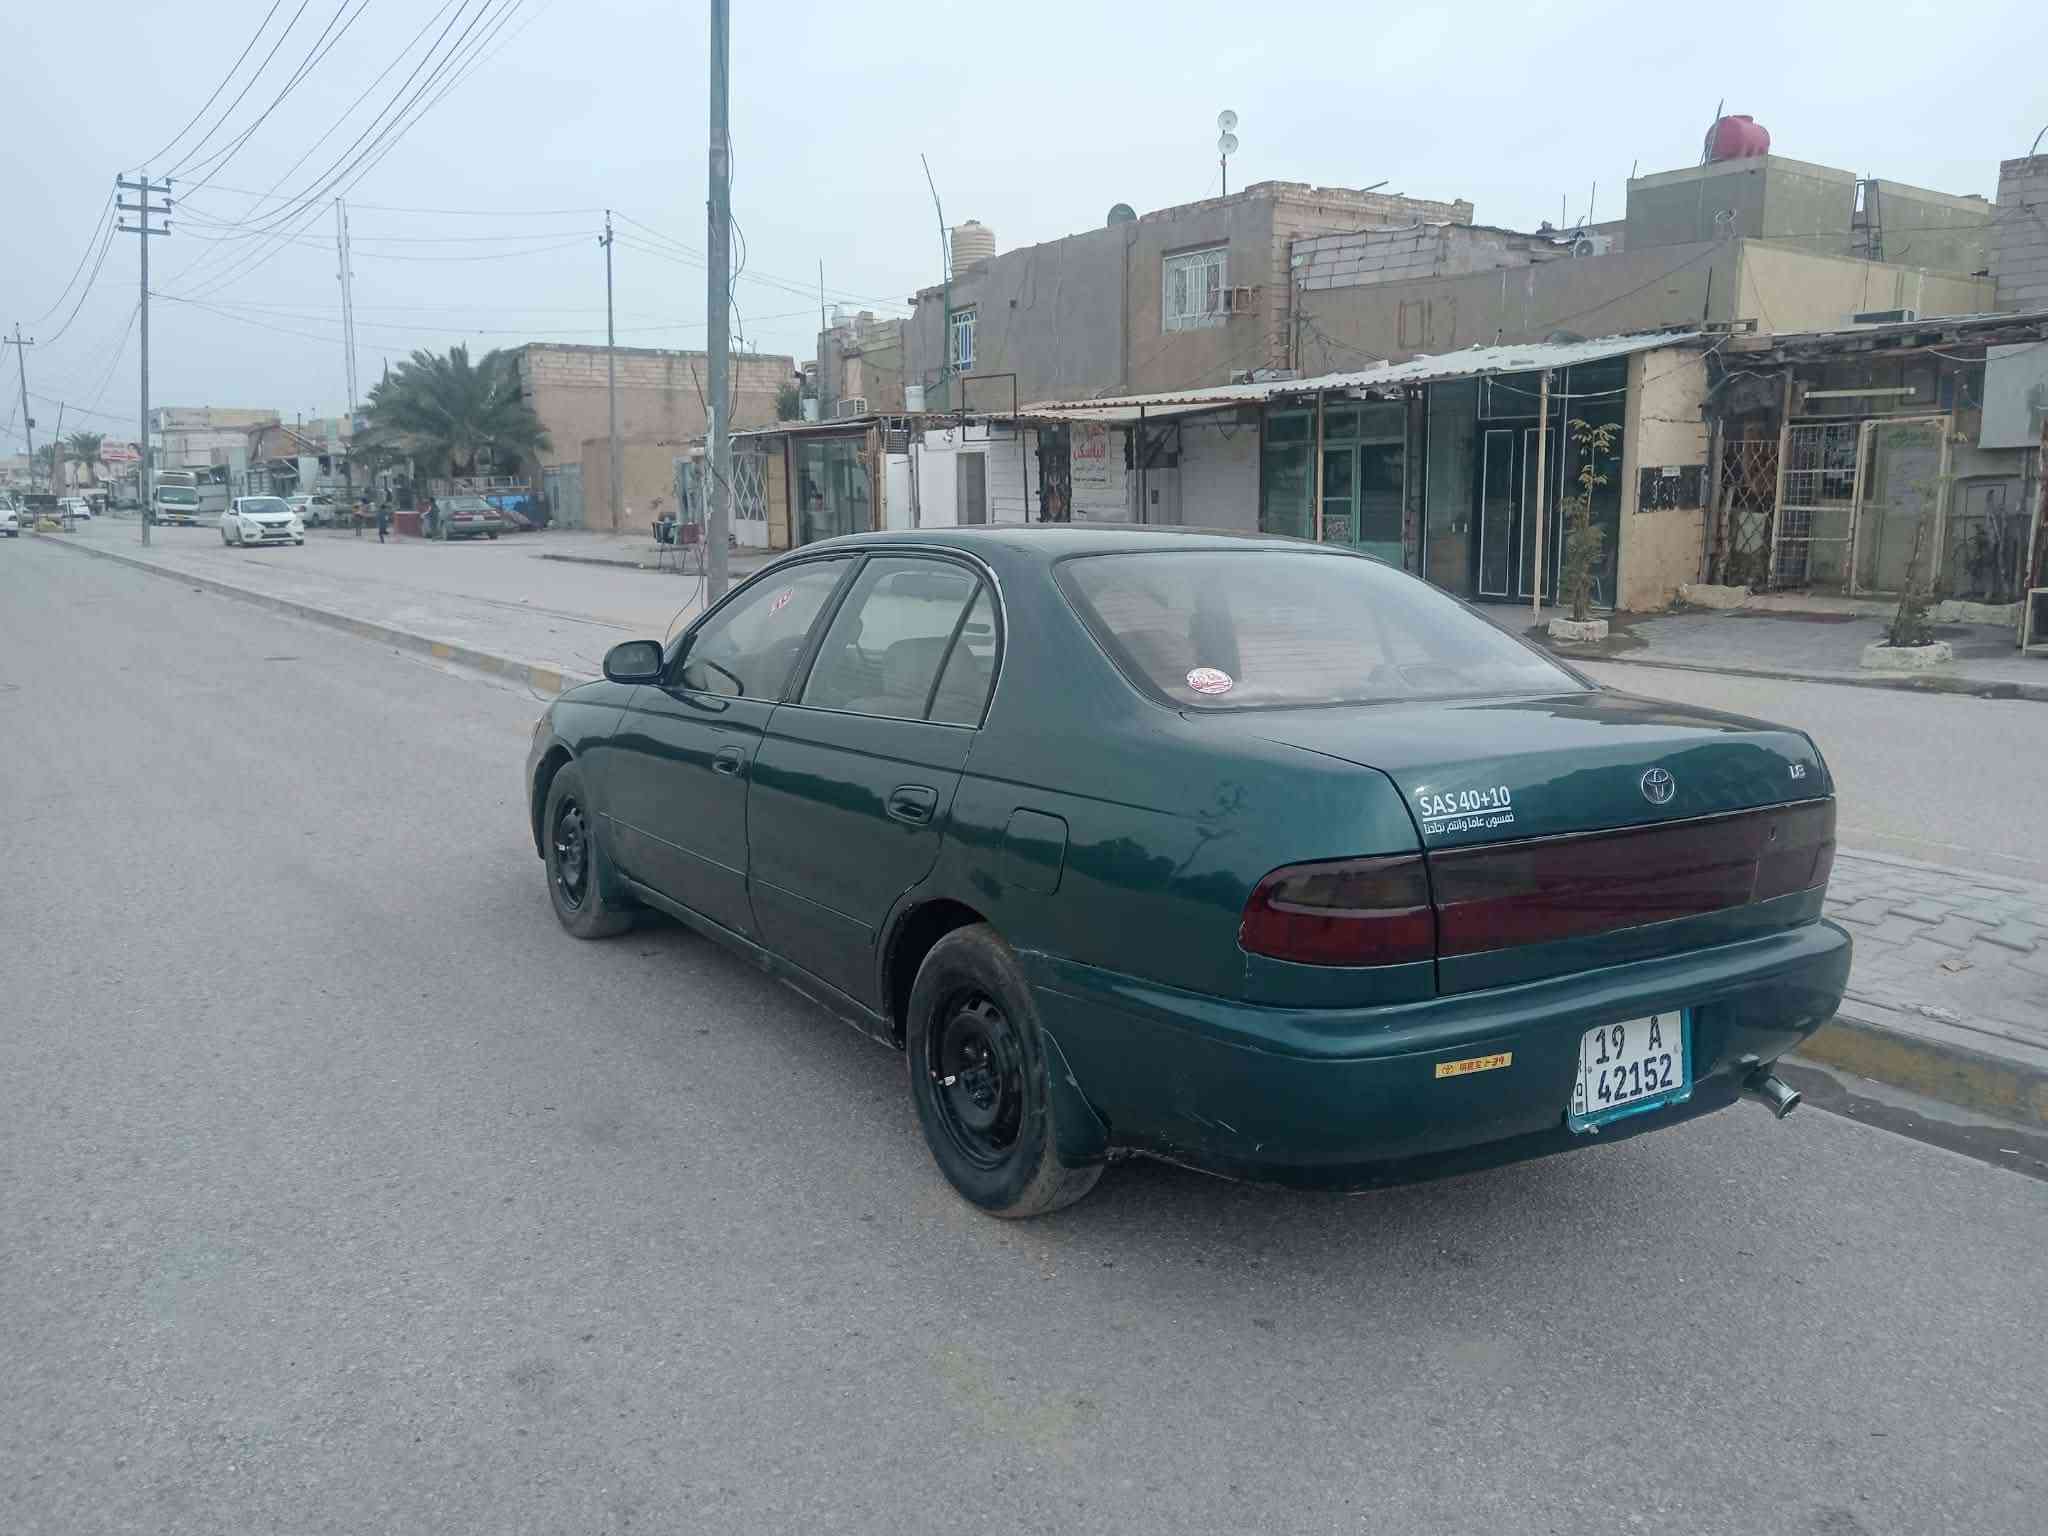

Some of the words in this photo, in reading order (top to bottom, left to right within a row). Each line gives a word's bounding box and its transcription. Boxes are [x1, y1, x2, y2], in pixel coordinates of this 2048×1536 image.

[1420, 793, 1457, 816] SAS
[1460, 785, 1511, 811] 40+10
[1595, 1024, 1625, 1065] 19
[1649, 1015, 1662, 1051] A
[1598, 1053, 1673, 1103] 42152
